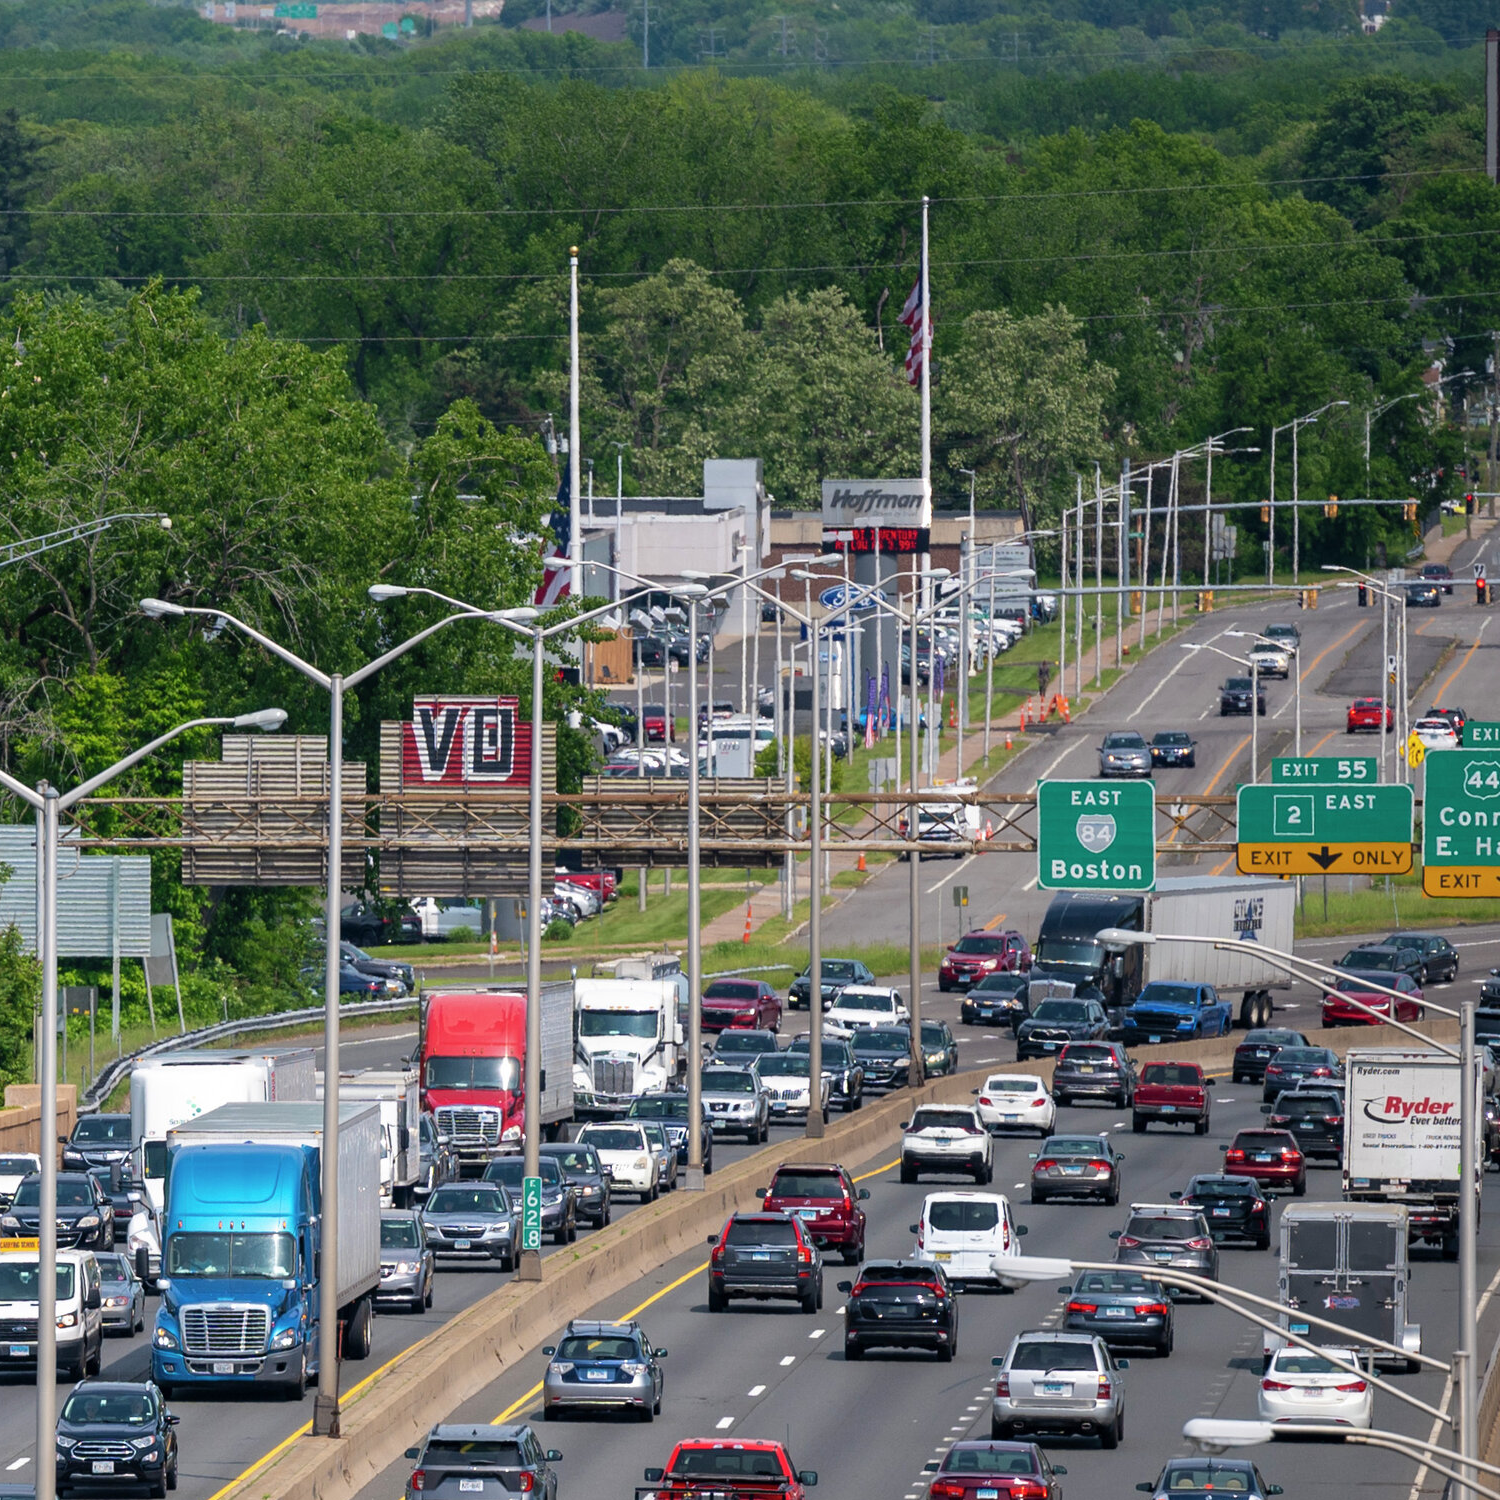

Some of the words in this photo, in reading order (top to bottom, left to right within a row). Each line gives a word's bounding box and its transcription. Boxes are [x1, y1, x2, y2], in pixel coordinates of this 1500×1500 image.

[830, 489, 923, 513] Hoffman
[1282, 763, 1320, 777] EXIT
[1337, 760, 1368, 779] 55
[1071, 790, 1122, 806] EAST
[1287, 806, 1302, 824] 2
[1326, 795, 1376, 810] EAST
[1081, 825, 1112, 843] 84
[1436, 835, 1459, 857] E.
[1251, 851, 1293, 865] EXIT
[1353, 850, 1404, 865] ONLY
[1052, 860, 1142, 880] Boston
[1440, 874, 1482, 889] EXIT
[1357, 1066, 1400, 1076] Ryder.com
[1384, 1096, 1454, 1118] Ryder
[1410, 1115, 1430, 1125] Ever
